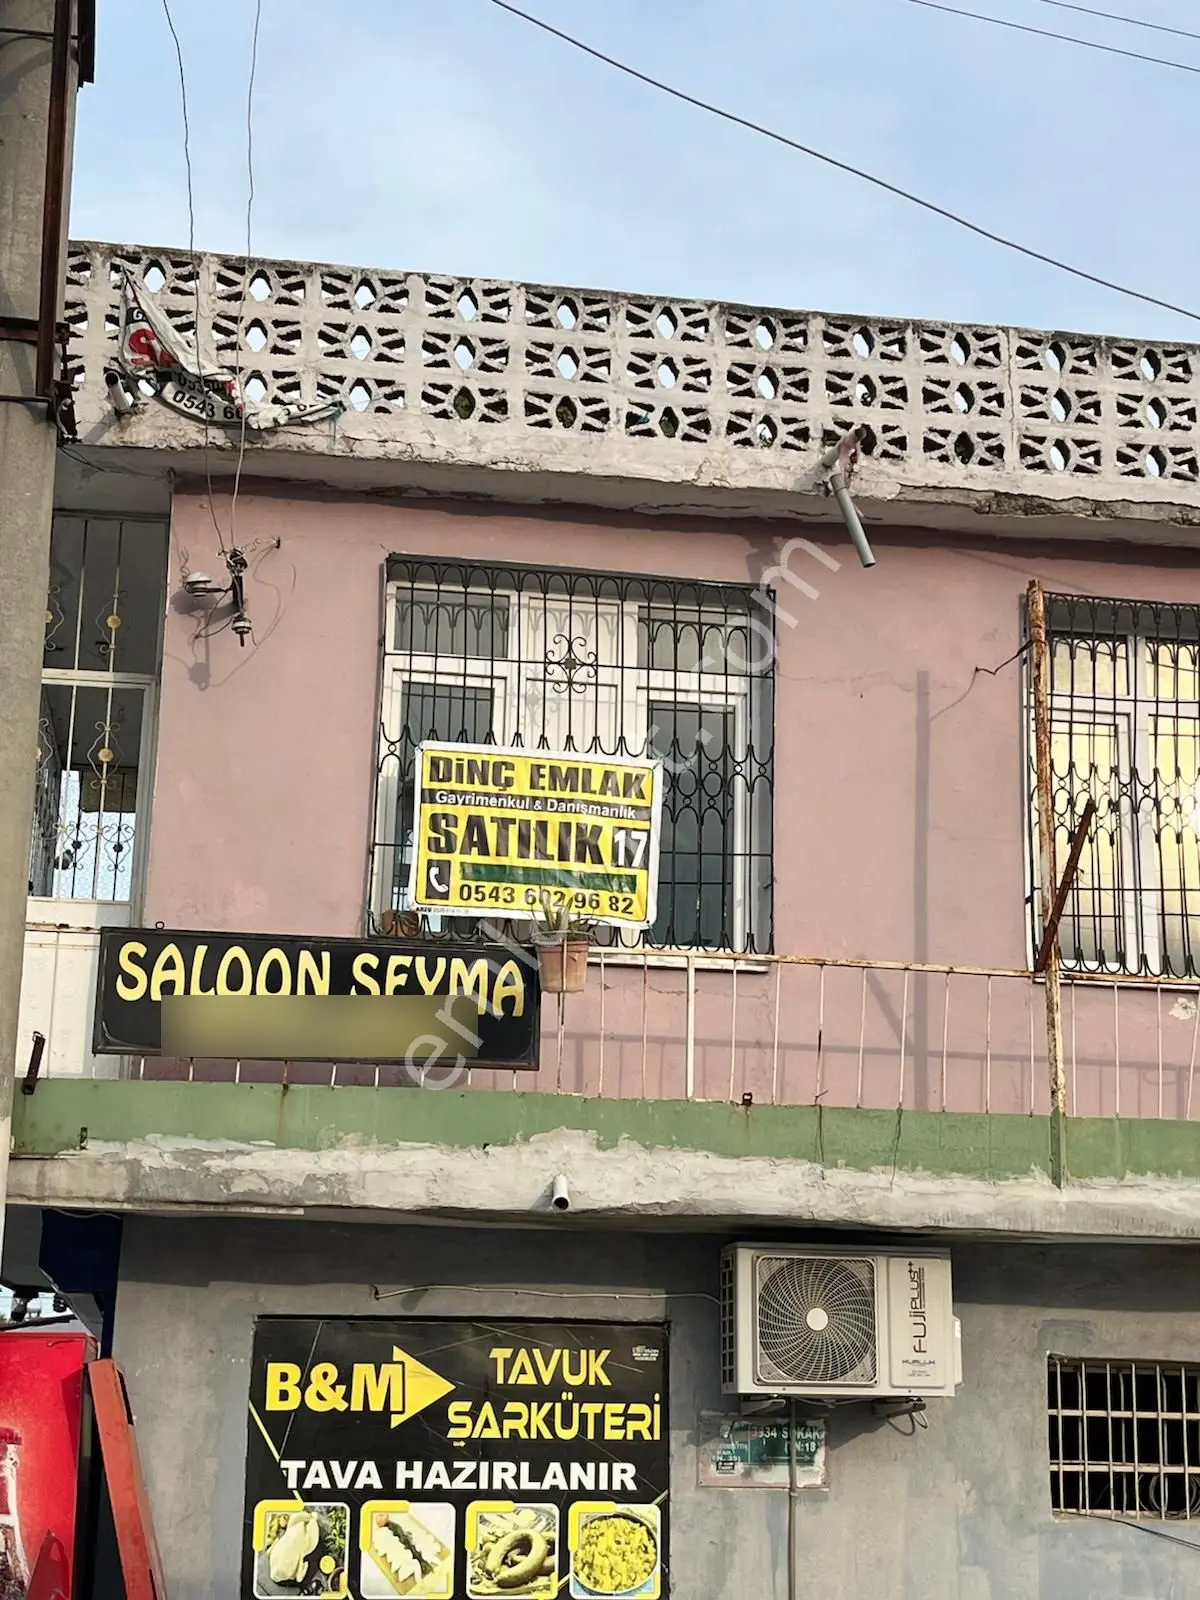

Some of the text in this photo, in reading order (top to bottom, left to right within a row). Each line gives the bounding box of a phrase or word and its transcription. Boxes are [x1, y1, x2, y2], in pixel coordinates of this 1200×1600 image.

[173, 390, 216, 419] 0543
[529, 763, 647, 800] EMLAK
[435, 791, 530, 811] Gayrimenkul
[533, 799, 543, 811] &
[428, 813, 648, 868] SATILIK 17
[459, 884, 515, 904] 0543
[574, 892, 600, 910] 96
[609, 896, 634, 915] 82
[115, 941, 331, 1001] SALOON
[488, 1348, 613, 1386] TAVUK
[265, 1362, 405, 1412] B&M
[446, 1391, 661, 1447] ŞARKÜTERİ
[280, 1460, 638, 1491] TAVA HAZIRLANIR
